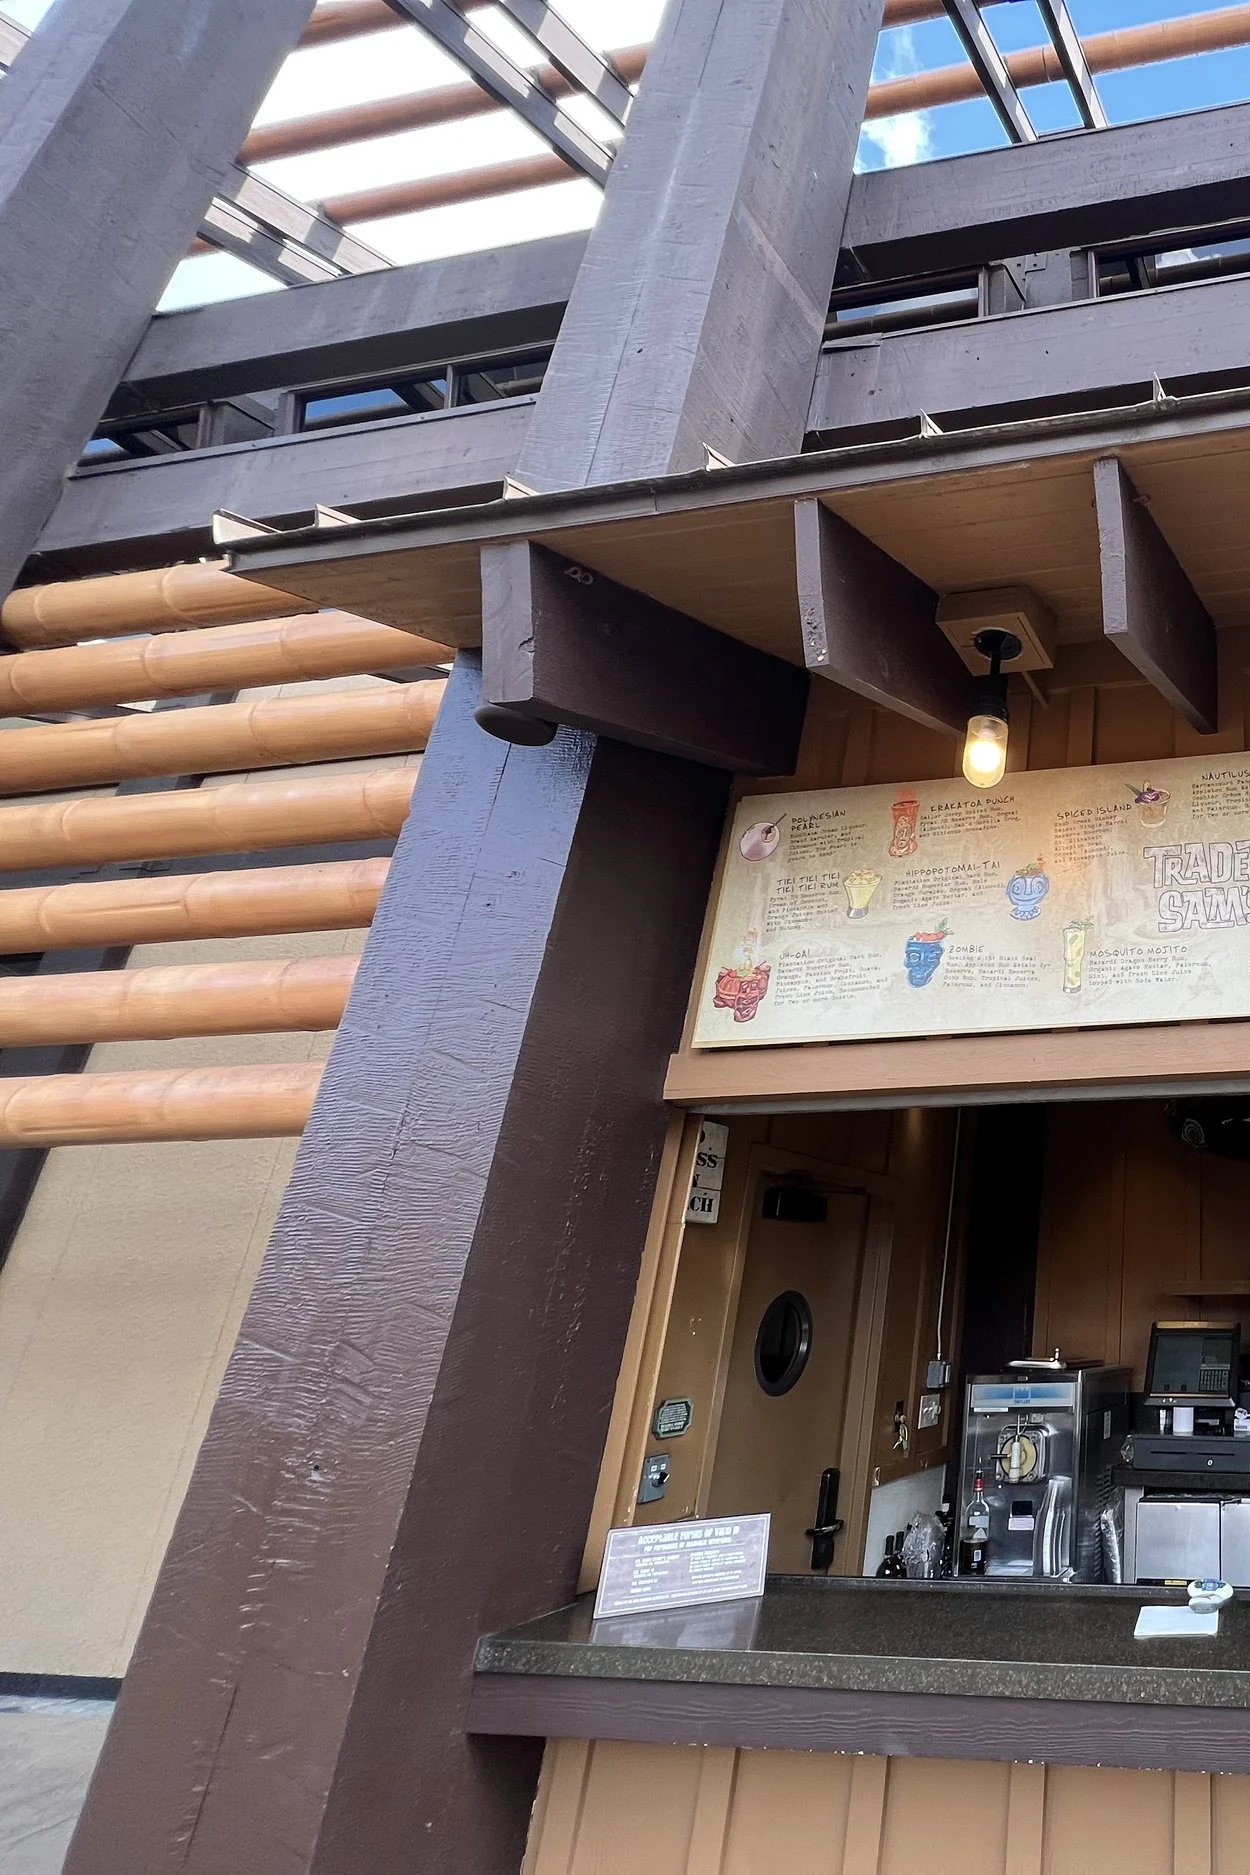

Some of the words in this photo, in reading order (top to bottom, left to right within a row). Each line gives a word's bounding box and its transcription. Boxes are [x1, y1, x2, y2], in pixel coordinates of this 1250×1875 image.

[1202, 770, 1250, 780] NAUTILUS
[931, 800, 982, 812] KRAKATOA
[986, 796, 1014, 805] PUNCH
[792, 810, 846, 823] POLYNESIAN
[1057, 809, 1092, 820] SPICED
[1097, 804, 1132, 814] ISLAND
[791, 823, 820, 831] PEARL
[906, 861, 999, 876] HIPPOPOTOMAI-TAI
[822, 872, 840, 880] TIKI
[776, 885, 794, 894] TIKI
[799, 883, 816, 891] TIKI
[950, 945, 984, 953] ZOMBIE
[1090, 948, 1143, 957] MOSQUITO
[1148, 946, 1187, 954] MOJITO
